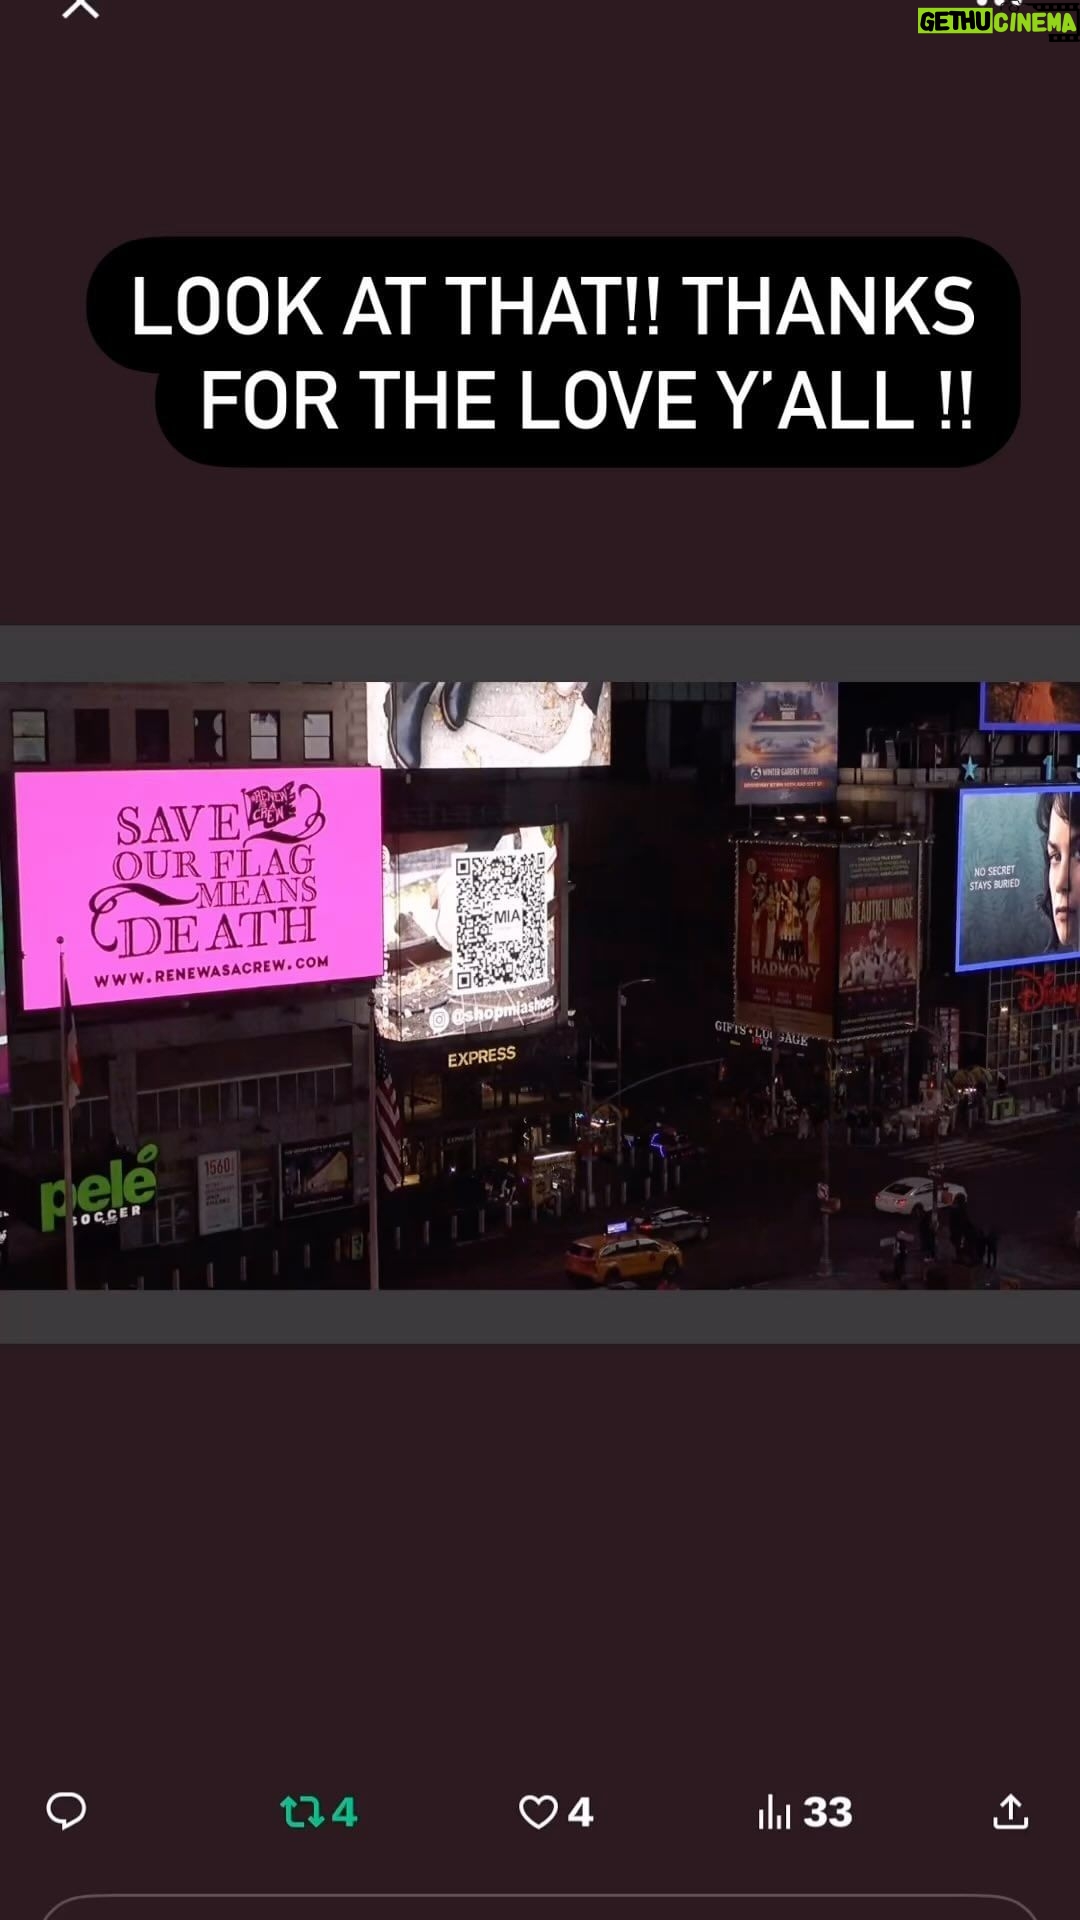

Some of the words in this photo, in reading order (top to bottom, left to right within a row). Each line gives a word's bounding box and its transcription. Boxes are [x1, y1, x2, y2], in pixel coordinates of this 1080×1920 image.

[762, 767, 781, 777] WINTER
[781, 767, 800, 777] GARDEN
[253, 789, 288, 803] RENEW
[117, 803, 241, 845] SAVE
[252, 805, 285, 823] CREW
[112, 850, 200, 881] OUR
[210, 844, 315, 879] FLAG
[974, 866, 985, 876] NO
[988, 865, 1016, 876] SECRET
[196, 876, 318, 909] MEANS
[969, 880, 992, 891] STAYS
[994, 879, 1020, 889] BURIED
[494, 909, 520, 923] MIA
[117, 906, 317, 959] DEATH
[94, 955, 329, 988] WWW.RENEWASACREW.COM
[751, 957, 821, 983] HARMONY
[452, 995, 555, 1025] @shopmiashoes
[714, 1020, 747, 1036] GIFTS
[447, 1045, 517, 1068] EXPRESS
[40, 1143, 158, 1232] pelé
